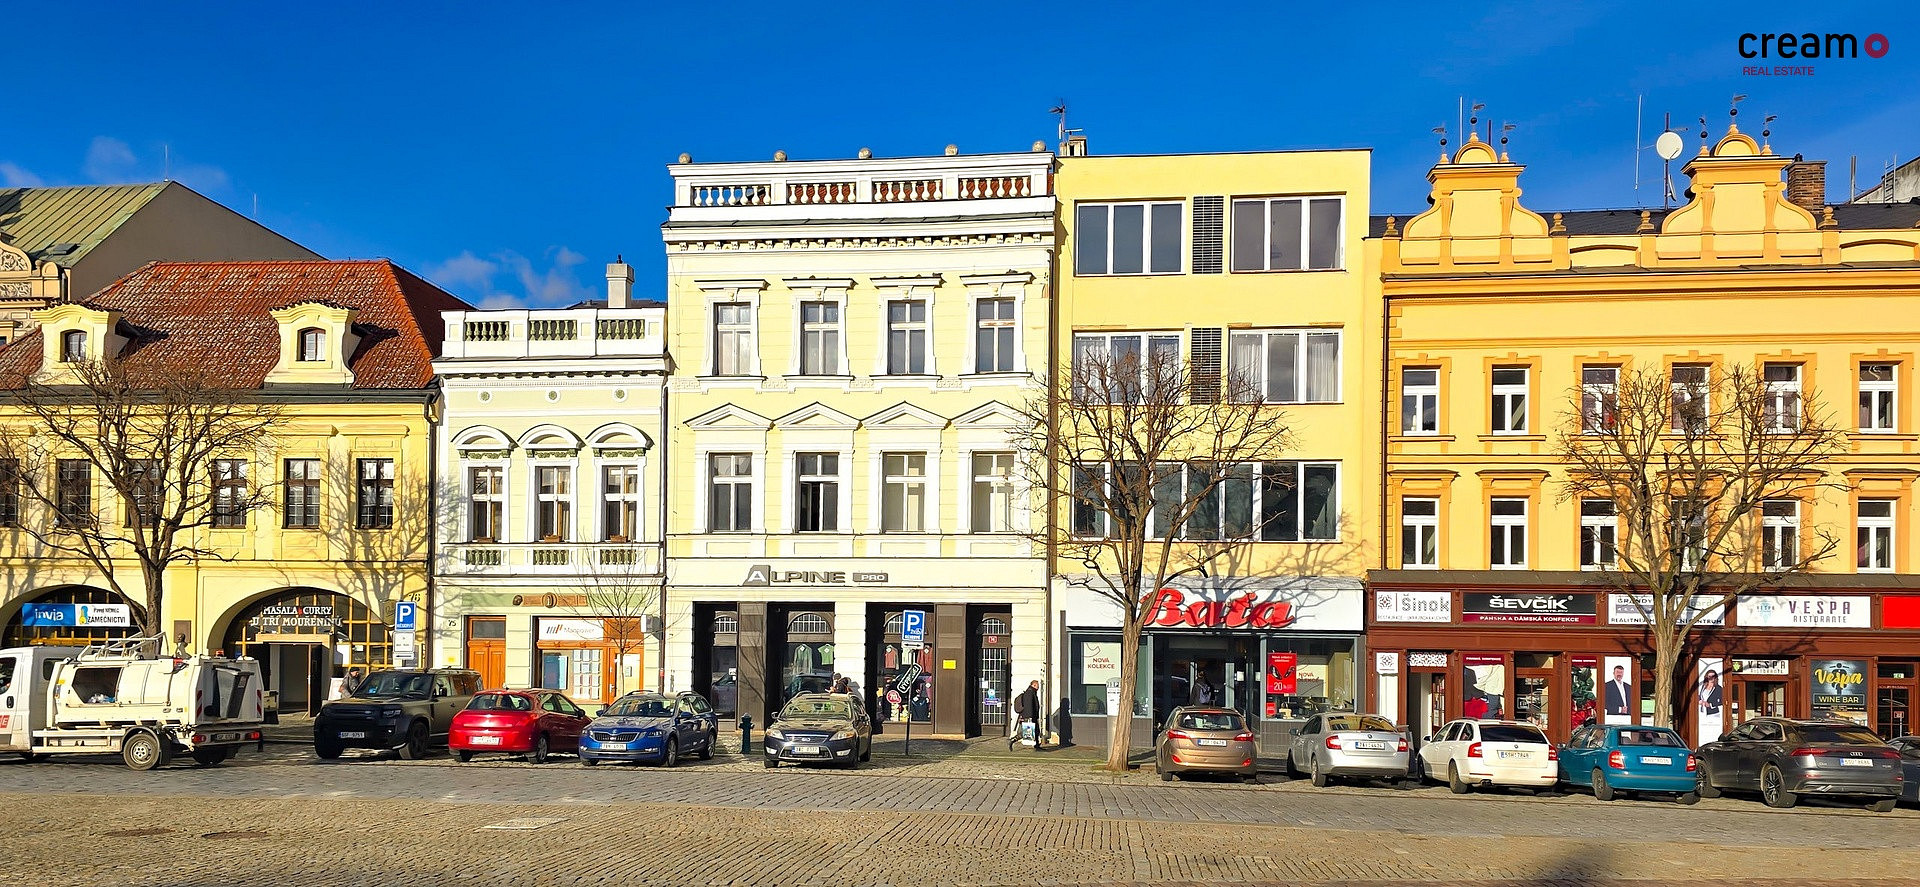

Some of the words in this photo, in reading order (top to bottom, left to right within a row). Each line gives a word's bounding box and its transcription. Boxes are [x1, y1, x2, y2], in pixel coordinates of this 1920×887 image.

[745, 568, 845, 585] ALPINE
[1402, 593, 1449, 612] Šinok
[1489, 595, 1569, 609] ŠEVČÍK
[1788, 601, 1851, 614] VESPA
[34, 608, 64, 621] invia
[263, 606, 298, 615] MASALA
[302, 606, 333, 615] CURRY
[399, 604, 412, 623] P
[252, 616, 260, 626] U
[448, 619, 457, 627] 75
[907, 614, 920, 632] P
[1793, 615, 1847, 623] RISTORANTE
[1748, 660, 1786, 669] VESPA
[1814, 668, 1864, 689] Vespa
[1273, 681, 1283, 691] 20
